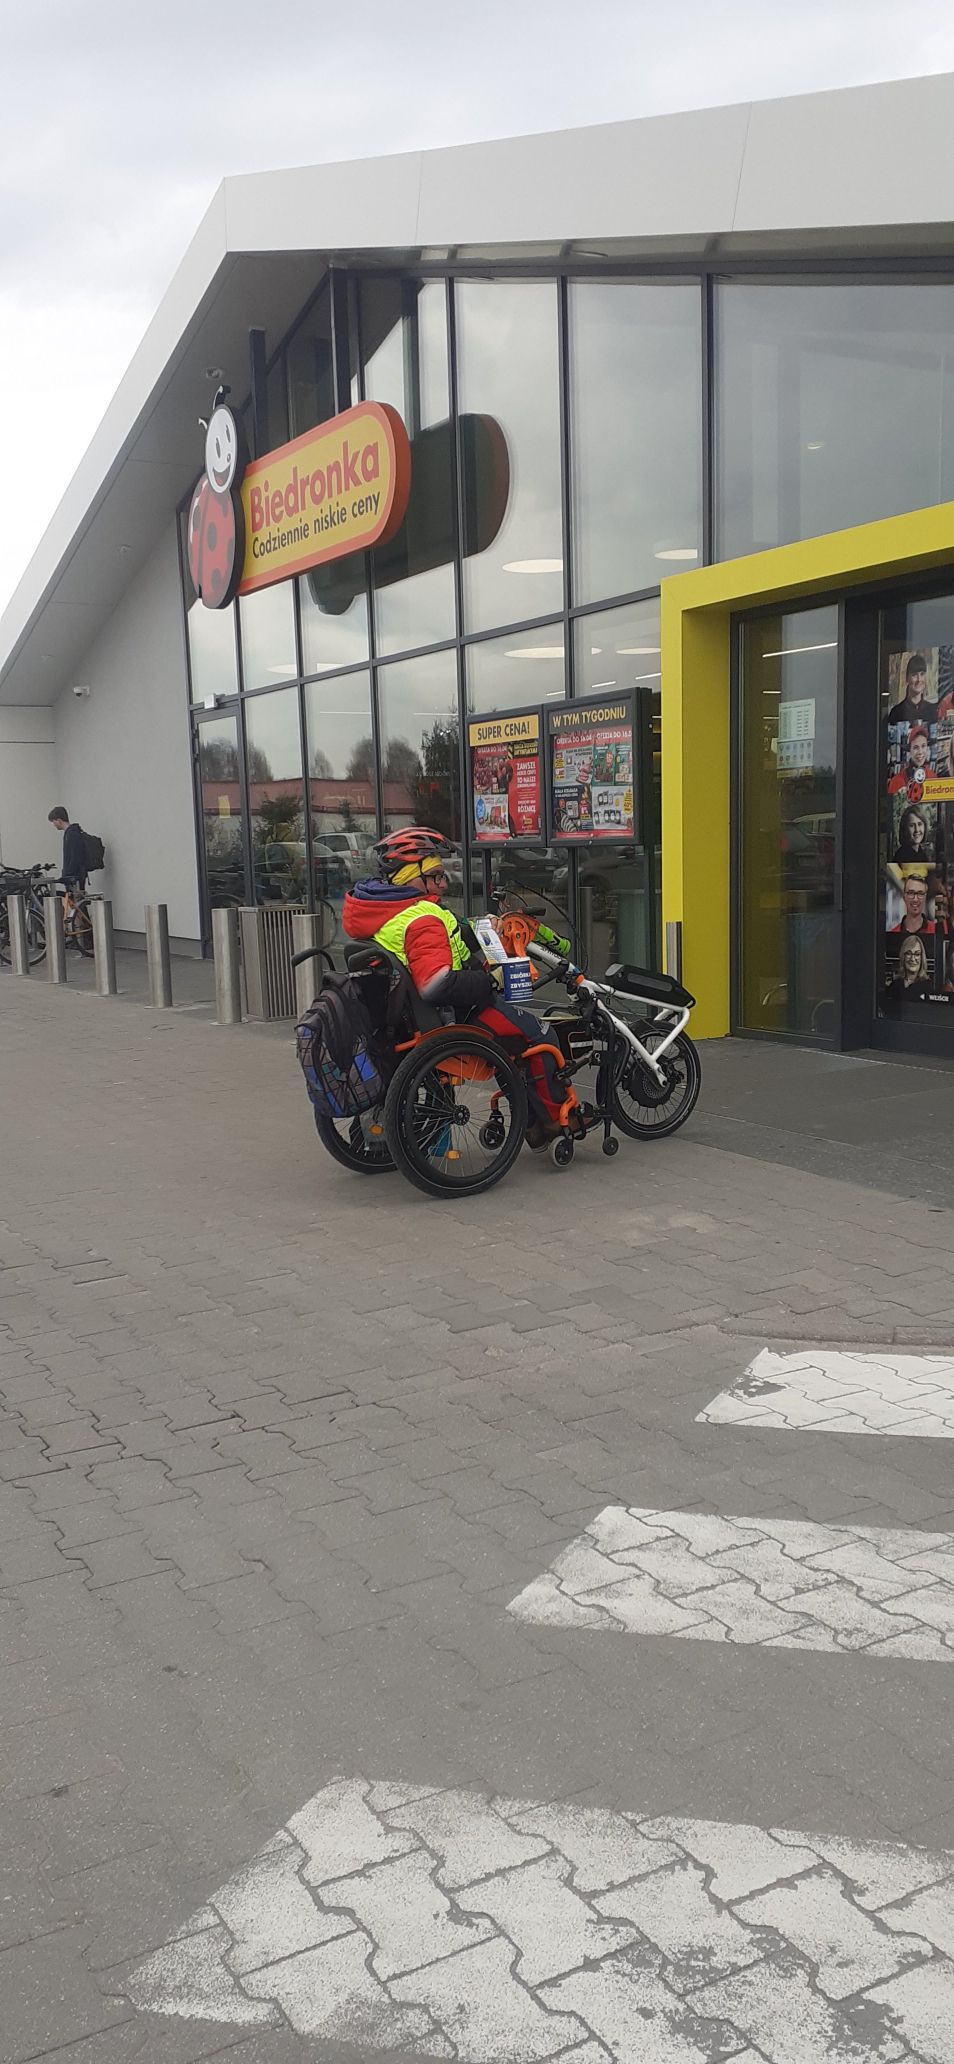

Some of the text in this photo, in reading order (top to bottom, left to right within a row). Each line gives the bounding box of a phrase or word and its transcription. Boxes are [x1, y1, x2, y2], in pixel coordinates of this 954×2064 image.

[250, 440, 380, 534] Biedronka
[252, 491, 380, 559] Codziennie niskie ceny
[477, 721, 530, 740] SUPER CENA!
[552, 705, 626, 728] W TYM TYGODNIU
